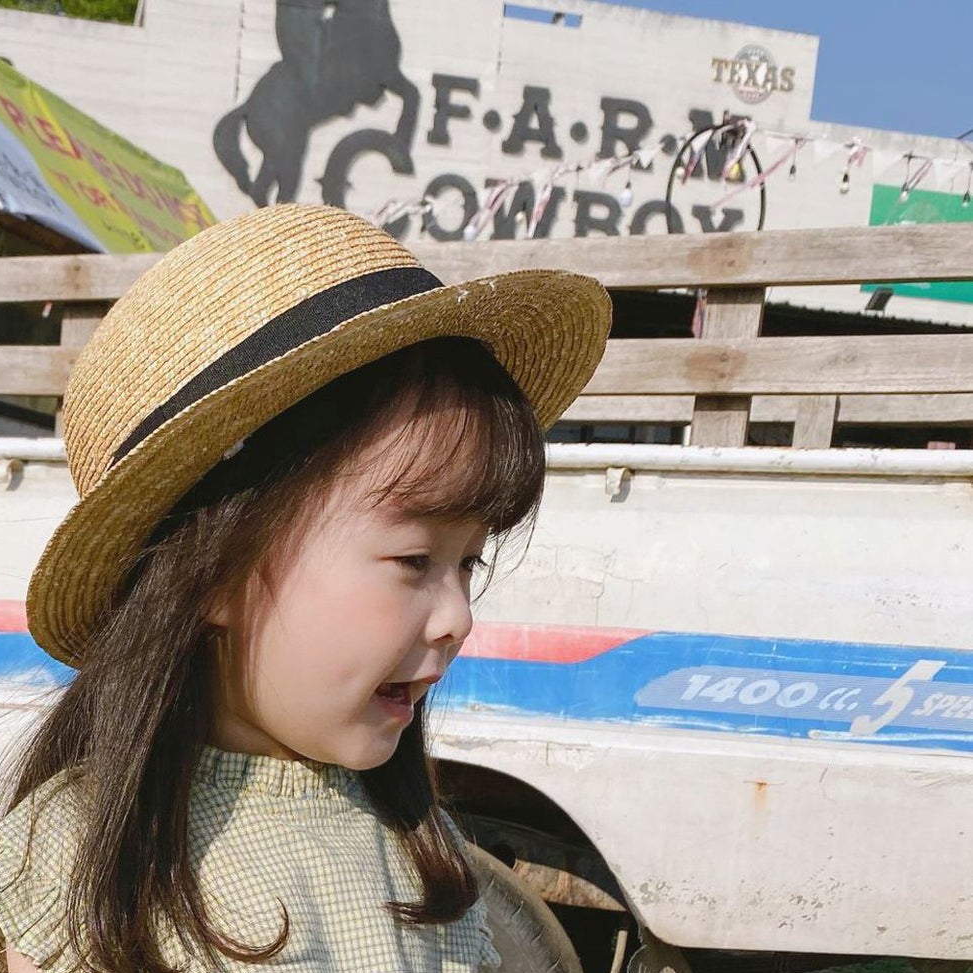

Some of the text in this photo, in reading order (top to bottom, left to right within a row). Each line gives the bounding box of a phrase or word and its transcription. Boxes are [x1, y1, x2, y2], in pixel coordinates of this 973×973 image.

[712, 58, 795, 93] TEXAS
[681, 674, 818, 708] 1400
[850, 659, 947, 737] 5
